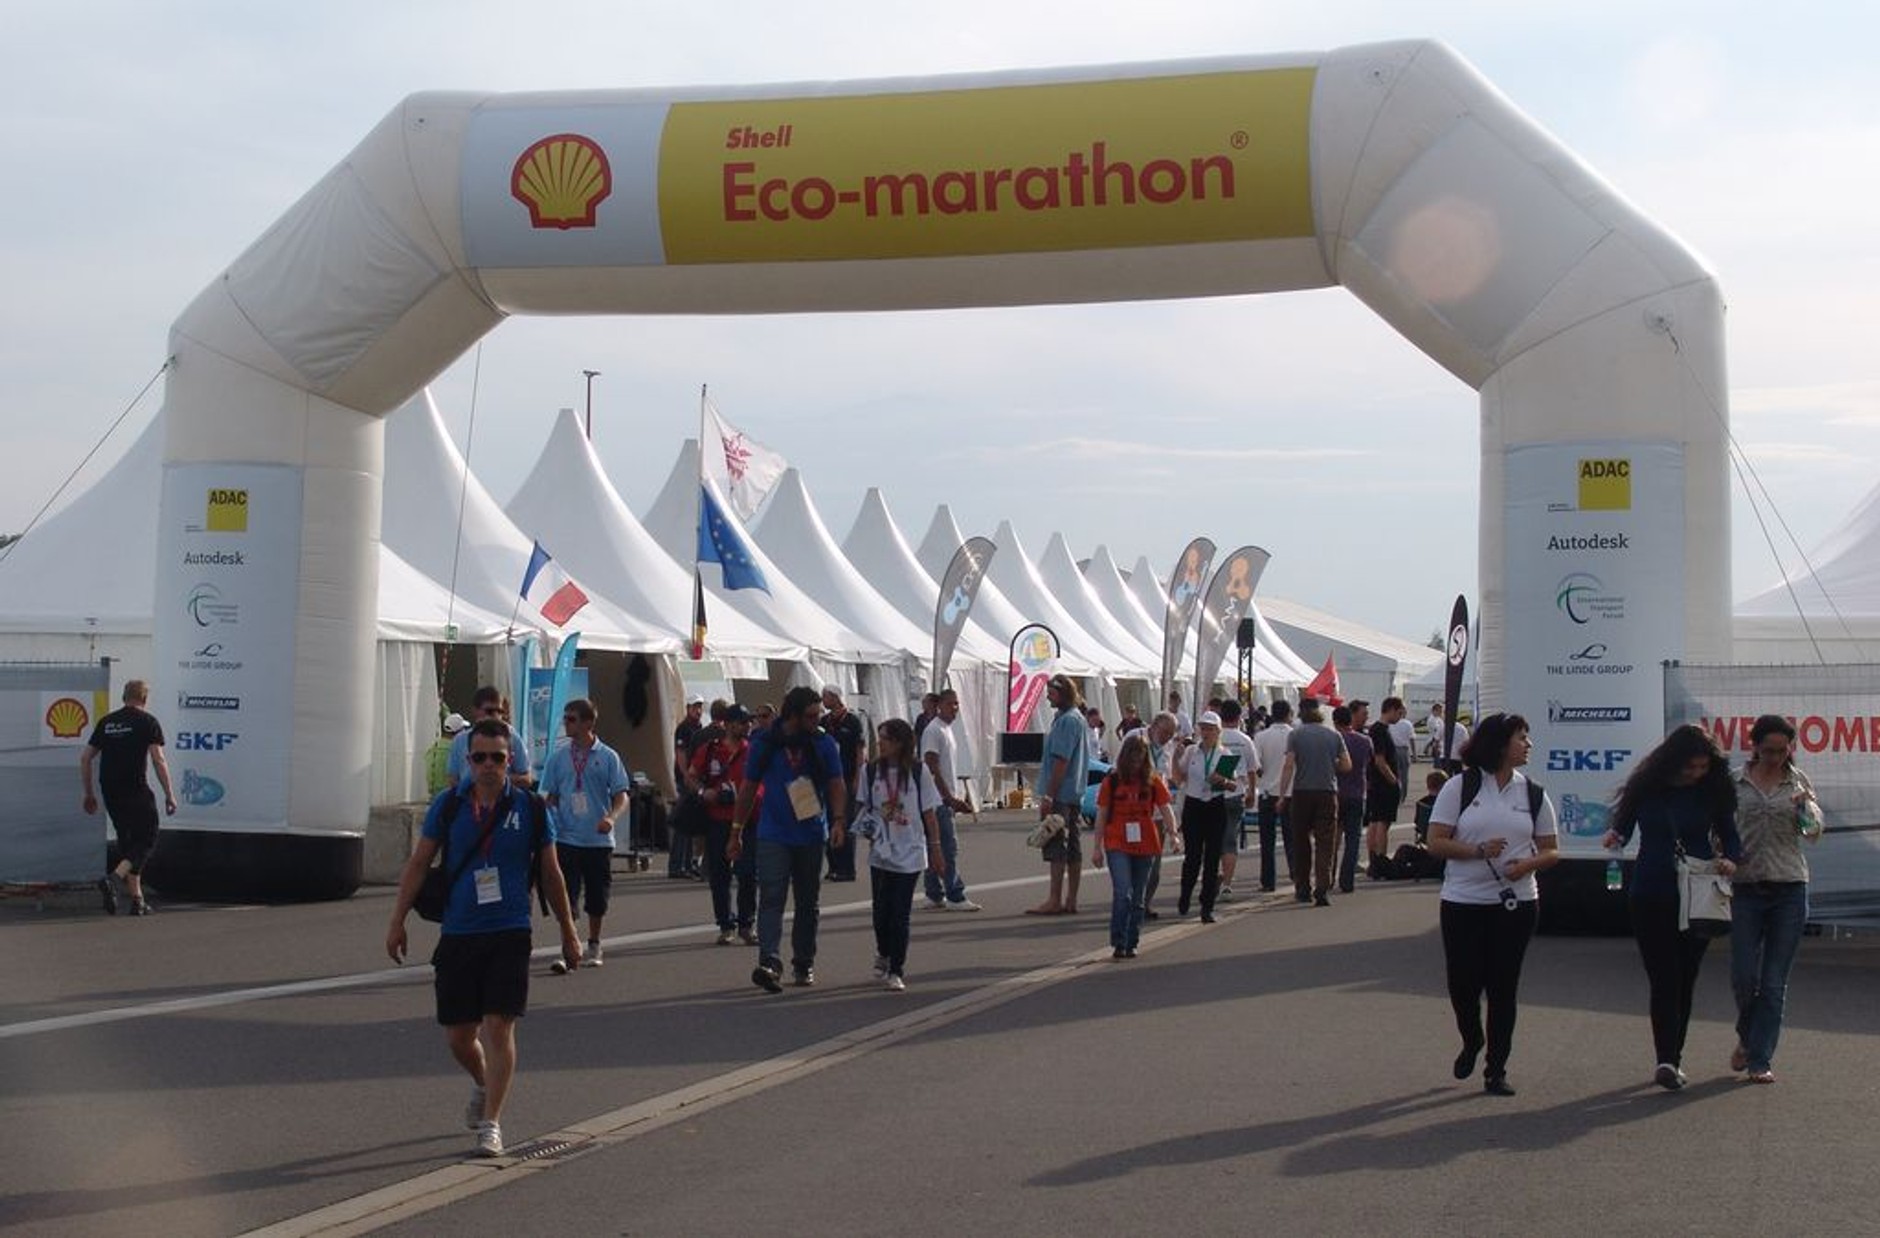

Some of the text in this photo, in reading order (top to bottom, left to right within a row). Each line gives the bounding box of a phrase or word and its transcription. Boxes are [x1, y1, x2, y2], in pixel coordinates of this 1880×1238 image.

[726, 125, 792, 149] Shell
[722, 142, 1236, 222] Eco-marathon
[1580, 460, 1630, 478] ADAC
[209, 490, 247, 505] ADAC
[1547, 533, 1629, 551] Autodesk
[184, 552, 244, 565] Autodesk
[1547, 665, 1634, 675] THE LINDE GROUP
[1564, 710, 1628, 718] MICHELIN
[176, 733, 239, 750] SKF
[1548, 750, 1632, 770] SKF
